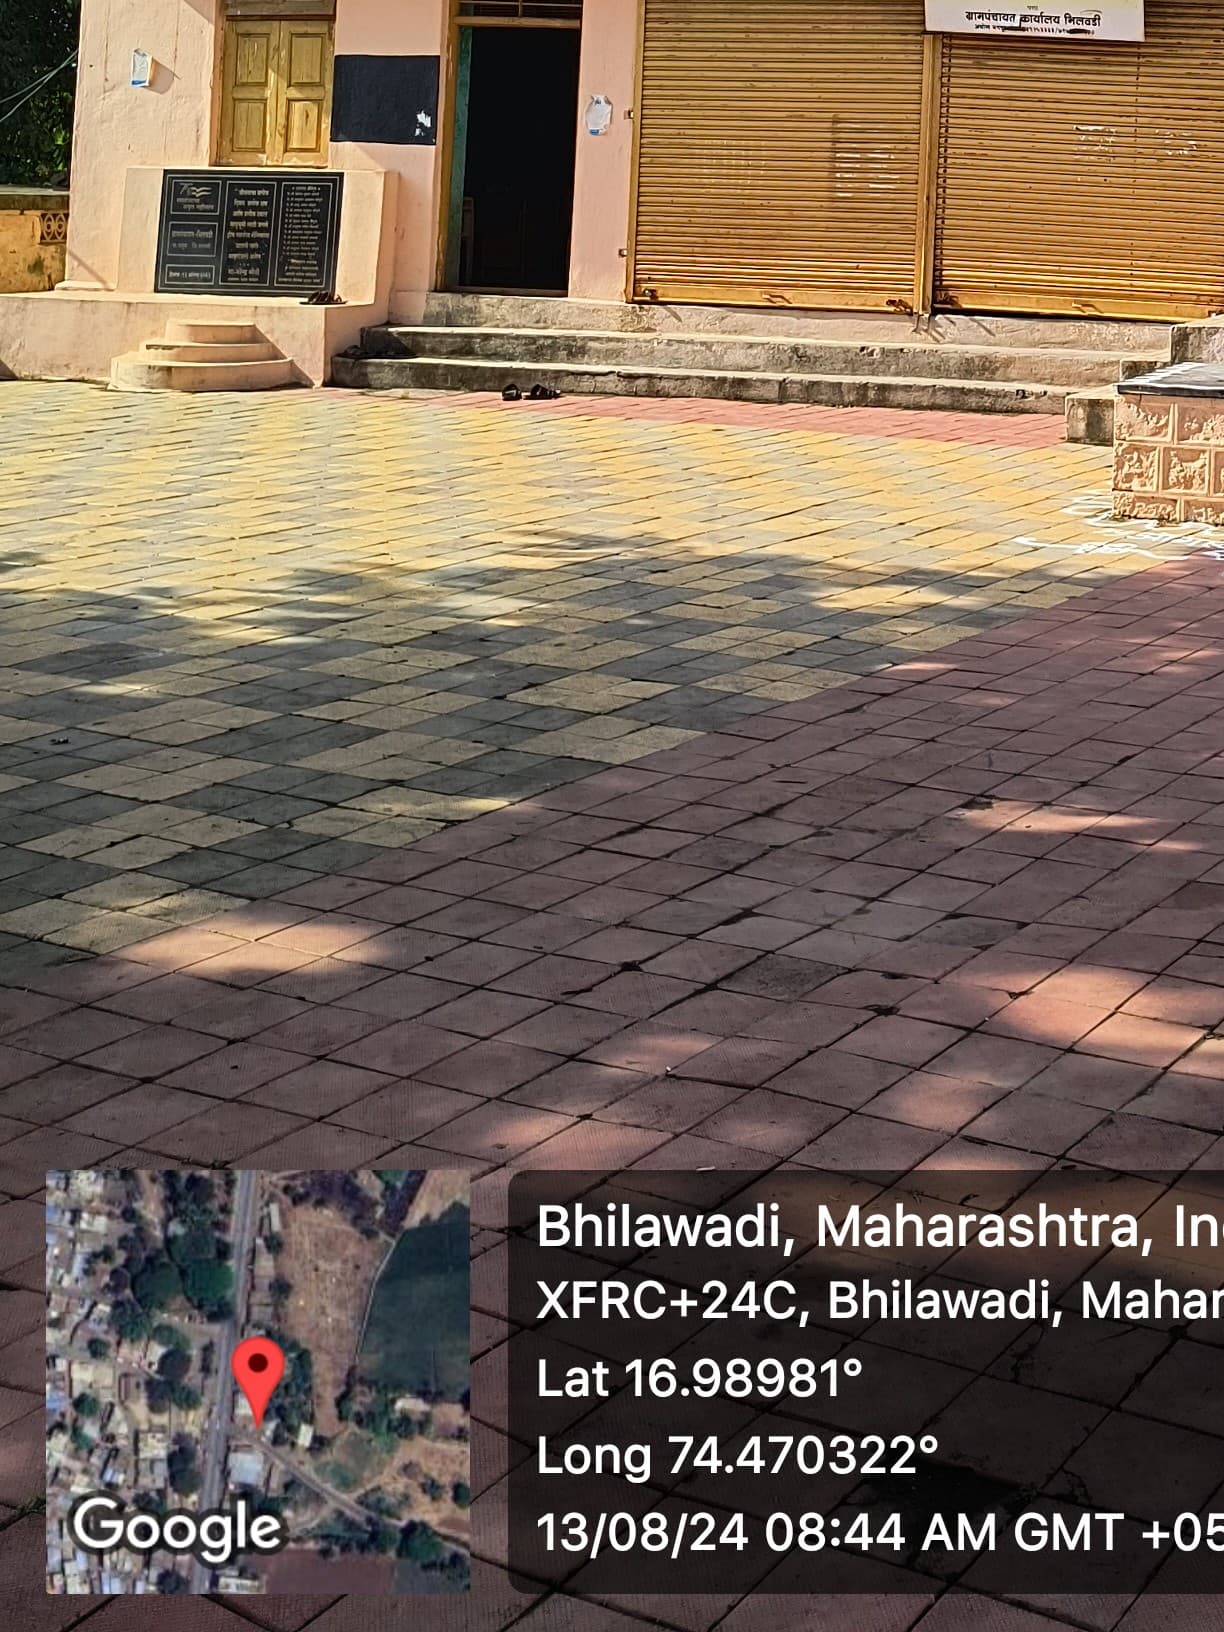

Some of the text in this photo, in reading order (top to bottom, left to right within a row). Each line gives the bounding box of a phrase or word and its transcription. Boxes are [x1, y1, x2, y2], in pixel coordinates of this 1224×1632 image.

[965, 9, 1101, 27] ग्रामपंचायत कार्यालय भिलवडी
